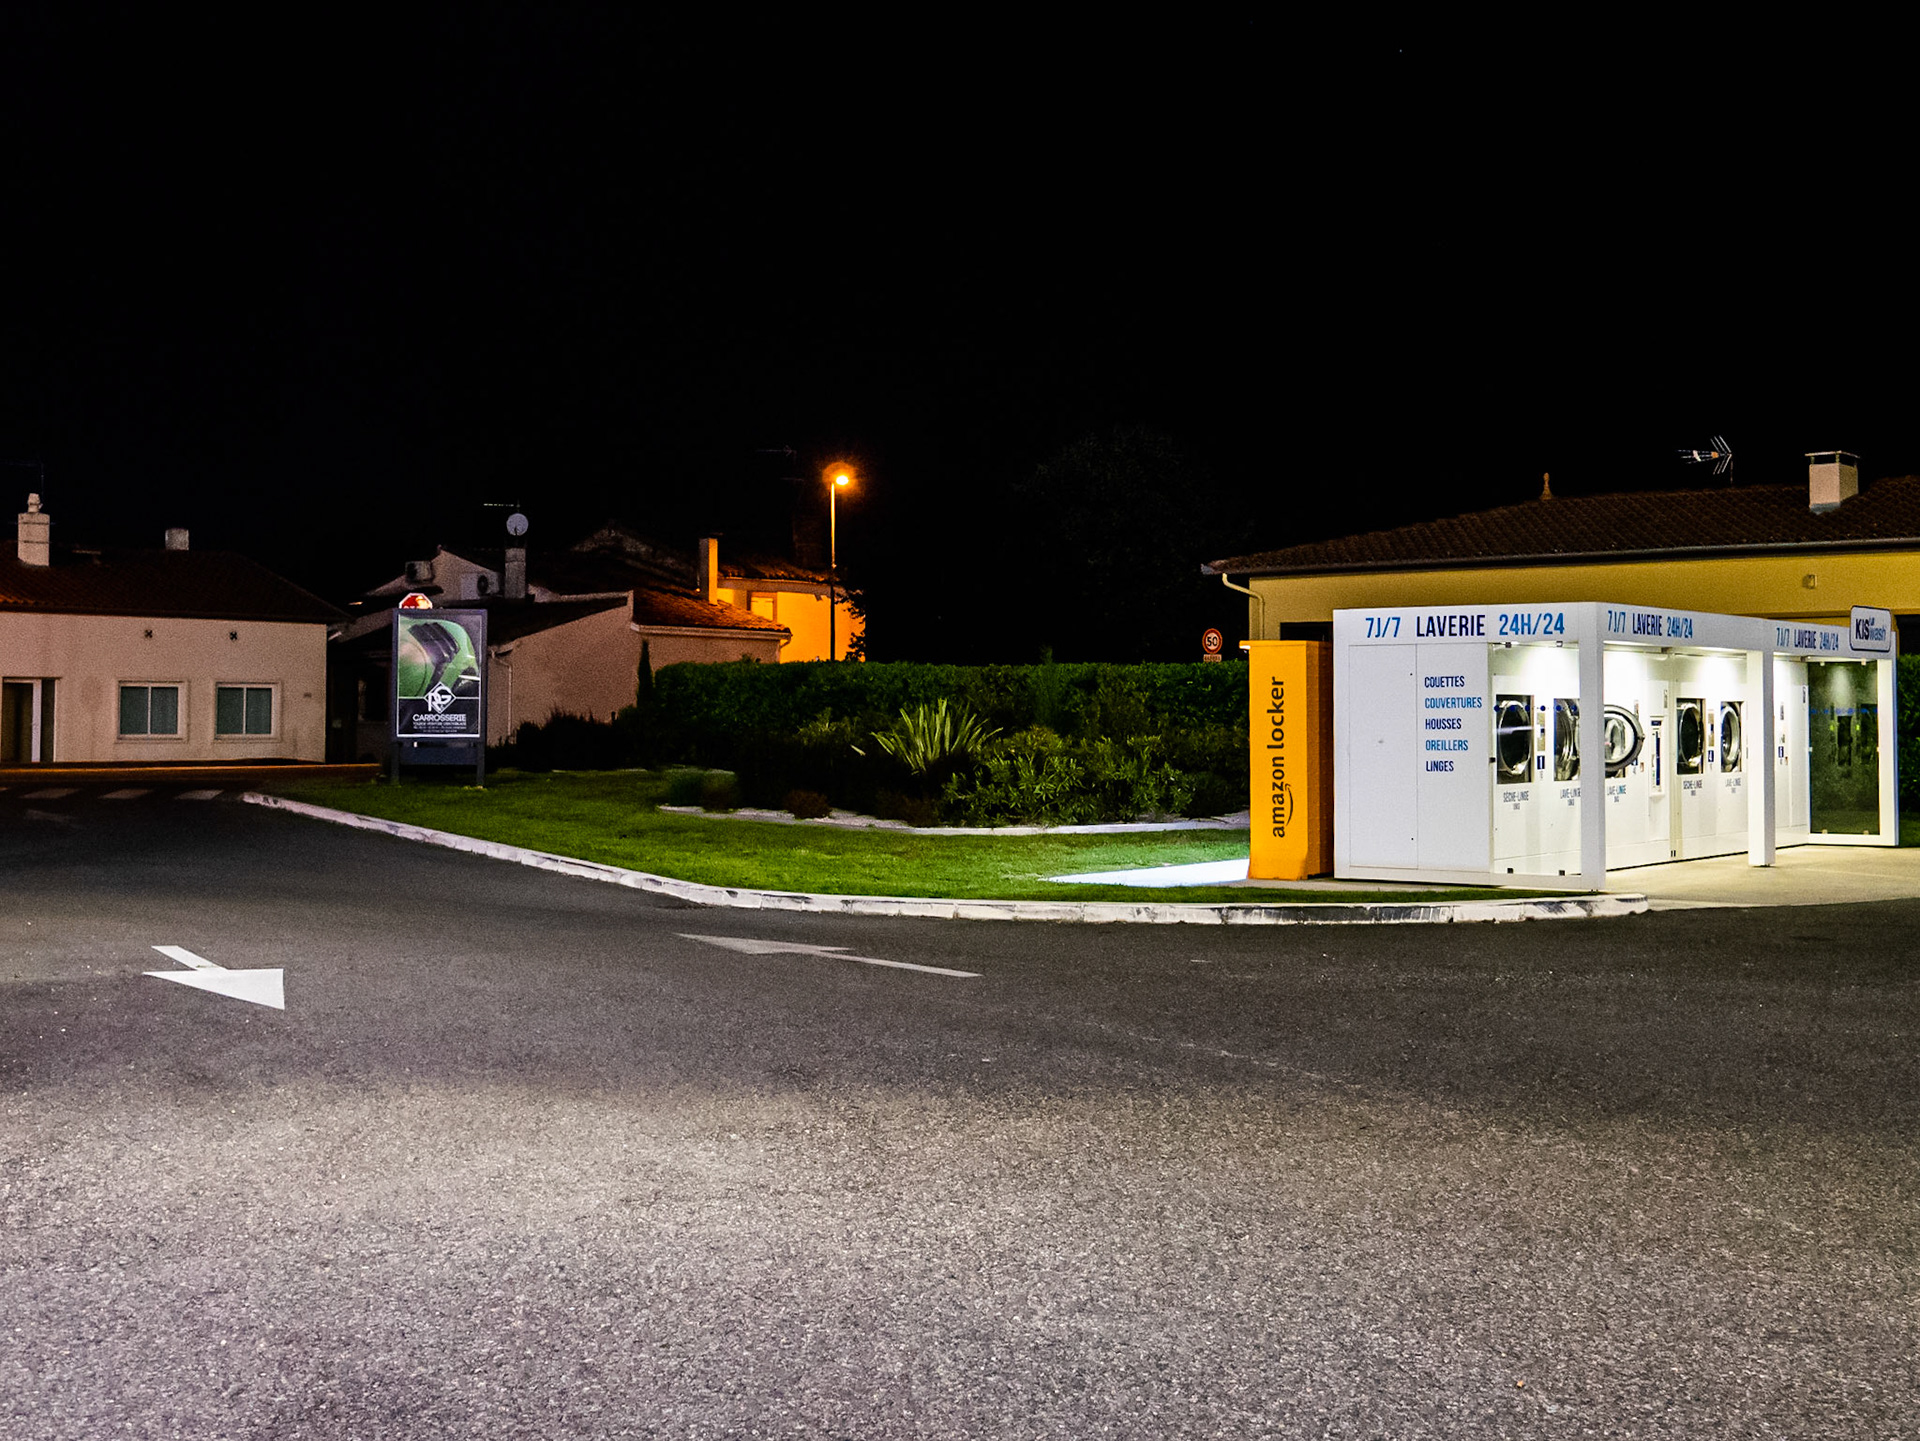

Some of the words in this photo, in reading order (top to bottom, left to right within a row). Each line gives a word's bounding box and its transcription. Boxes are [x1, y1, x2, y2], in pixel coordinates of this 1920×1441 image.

[1365, 617, 1401, 639] 7J/7
[1416, 614, 1486, 637] LAVERIE
[1498, 612, 1565, 635] 24H/24
[1607, 609, 1626, 634] 7J/7
[1632, 612, 1662, 637] LAVERIE
[1666, 616, 1693, 639] 24H/24
[1855, 618, 1870, 640] KIS
[1206, 636, 1218, 647] 50
[1794, 629, 1817, 649] LAVERIE
[1424, 675, 1465, 688] COUETTES
[1424, 696, 1482, 709] COUVERTURES
[412, 713, 467, 721] CARROSSERIE
[1267, 676, 1285, 749] locker
[1425, 718, 1462, 730] HOUSSES
[1425, 739, 1469, 751] OREILLERS
[1426, 760, 1454, 772] LINGES
[1271, 756, 1293, 838] amazon
